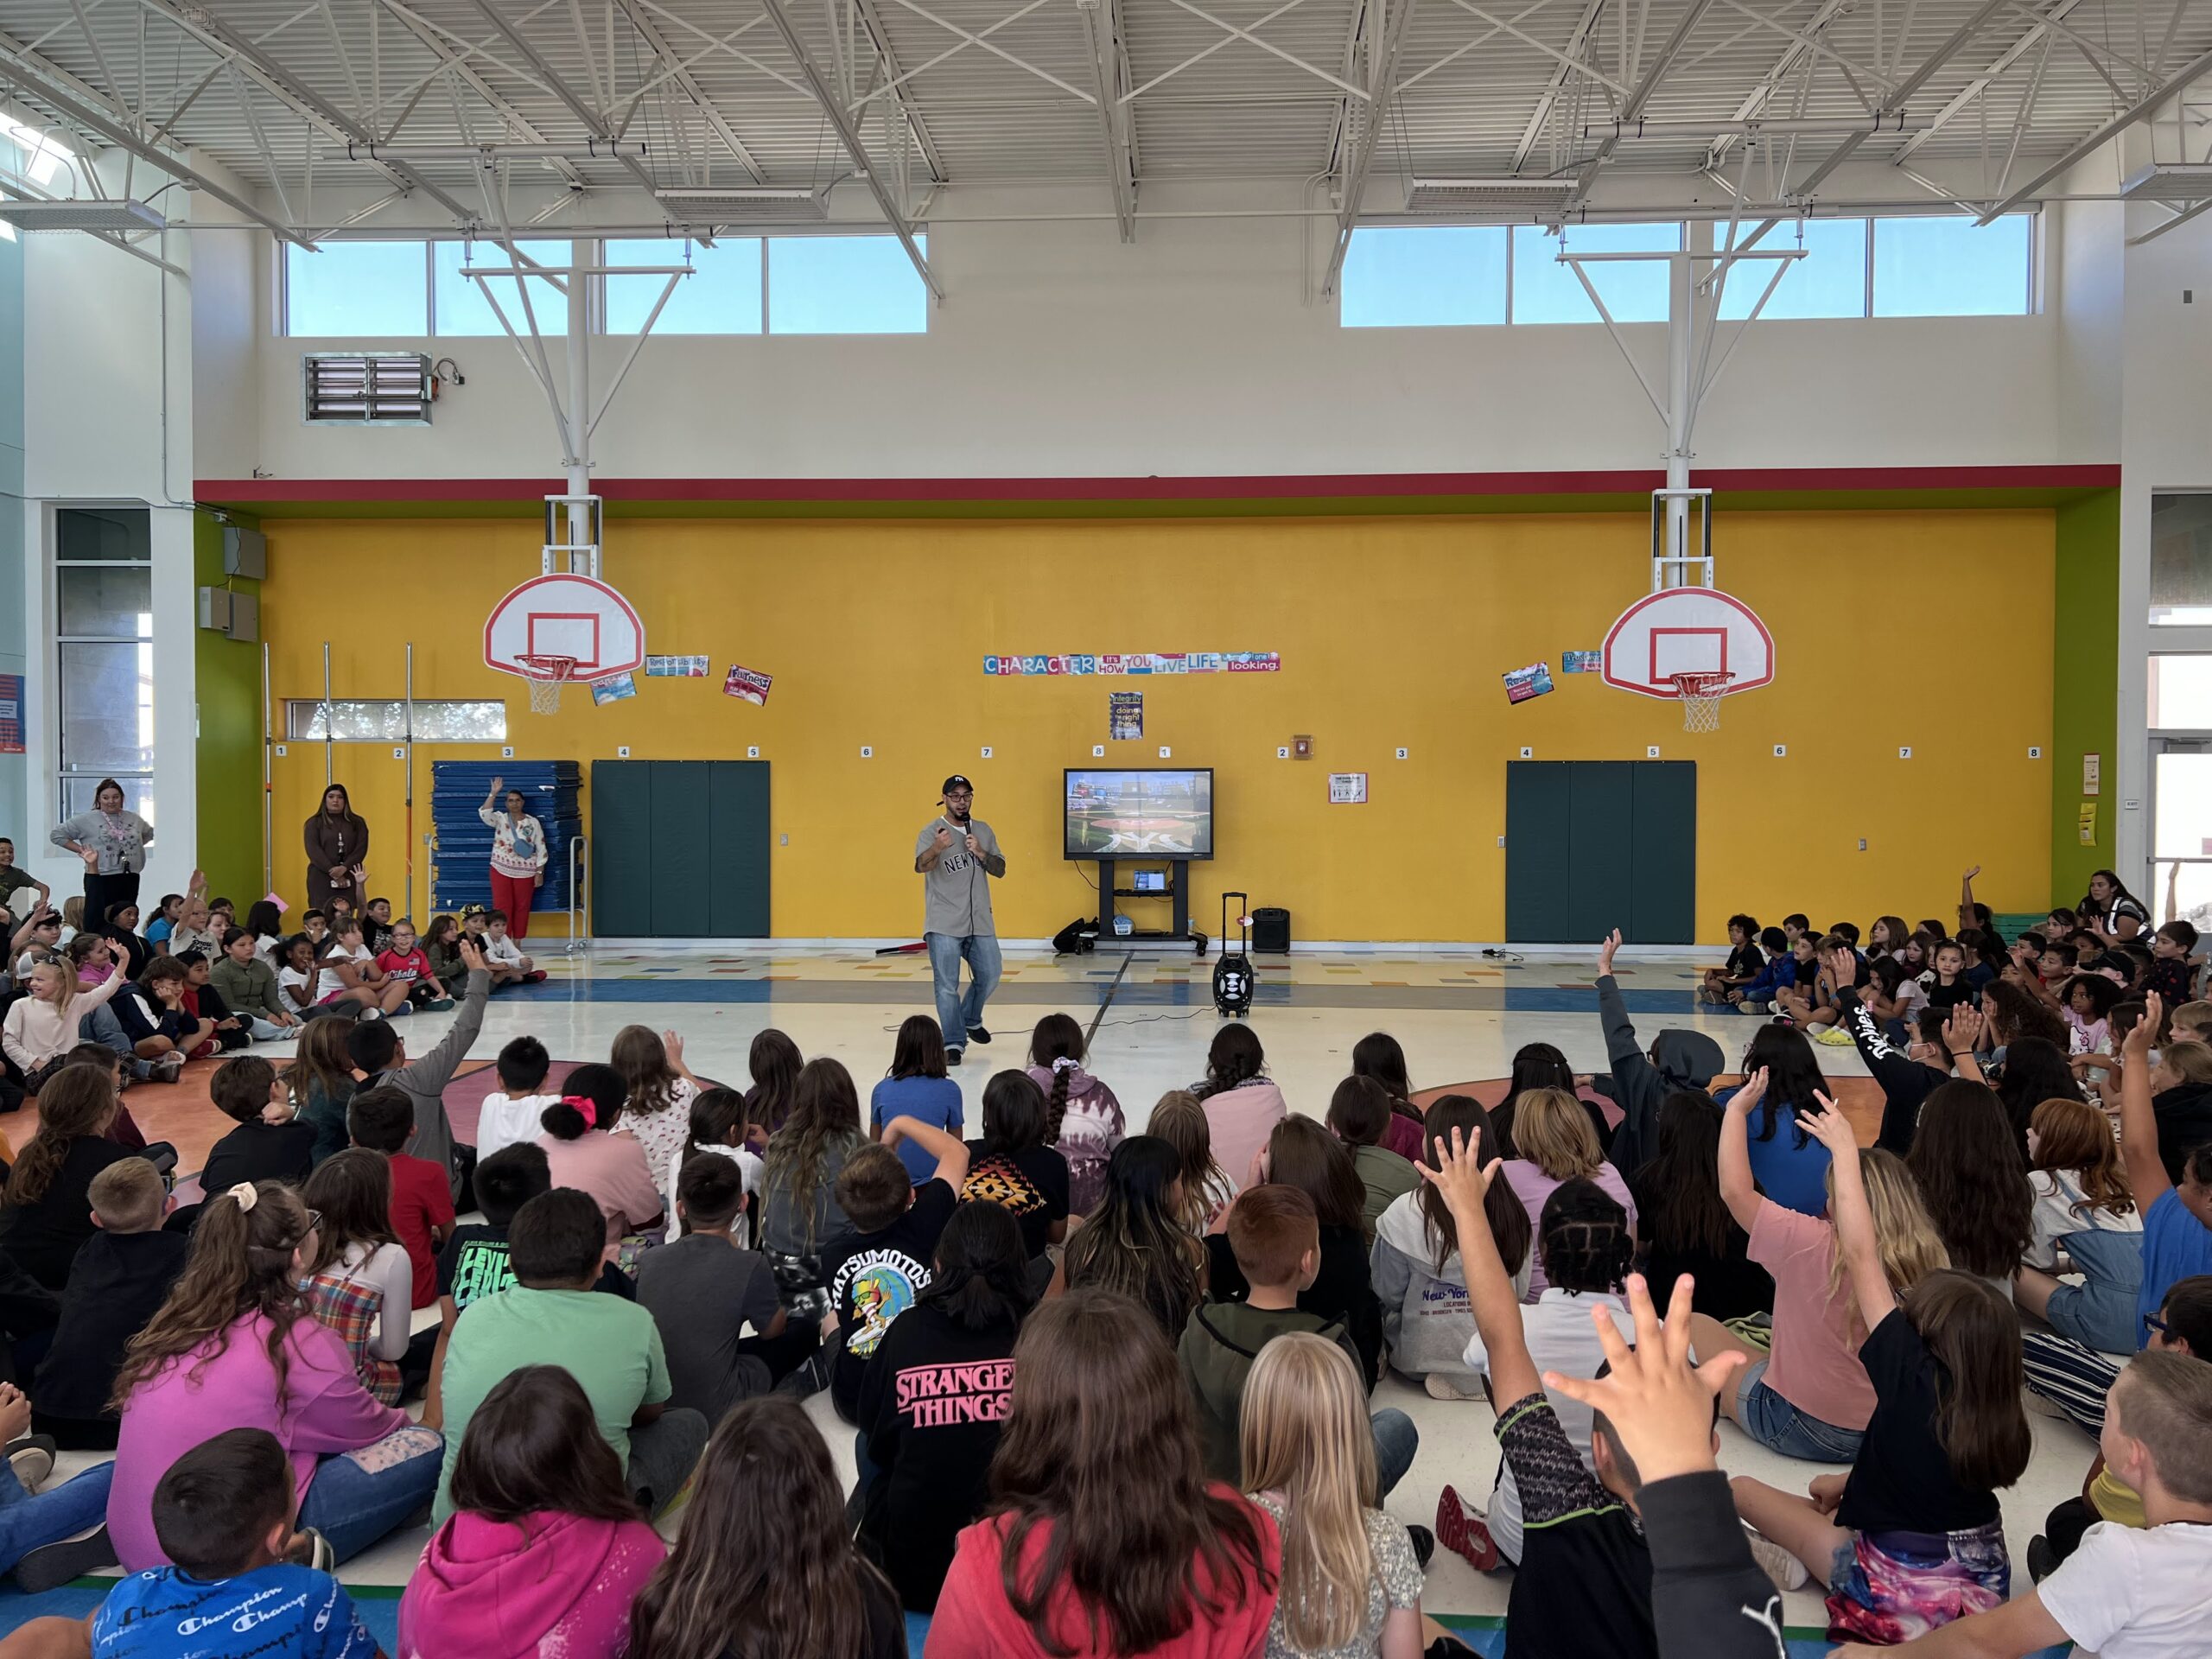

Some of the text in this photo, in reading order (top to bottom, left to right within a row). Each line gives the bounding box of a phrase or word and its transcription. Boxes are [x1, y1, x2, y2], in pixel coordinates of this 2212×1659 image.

[985, 656, 1094, 674] CHARACTER
[1099, 664, 1125, 673] HOW
[1126, 655, 1151, 667] YOU
[1155, 659, 1186, 672] LIVE
[1188, 654, 1218, 668] LIFE
[1231, 660, 1279, 671] looking.
[733, 669, 768, 688] Fairness
[944, 853, 969, 874] NEW
[1853, 1004, 1894, 1060] Dickies
[832, 1249, 932, 1310] MATSUMOTO'S
[1422, 1289, 1447, 1301] New
[896, 1364, 1015, 1408] STRANGE
[911, 1392, 1014, 1429] THINGS
[177, 1586, 283, 1636] Champion
[232, 1592, 308, 1633] Champ
